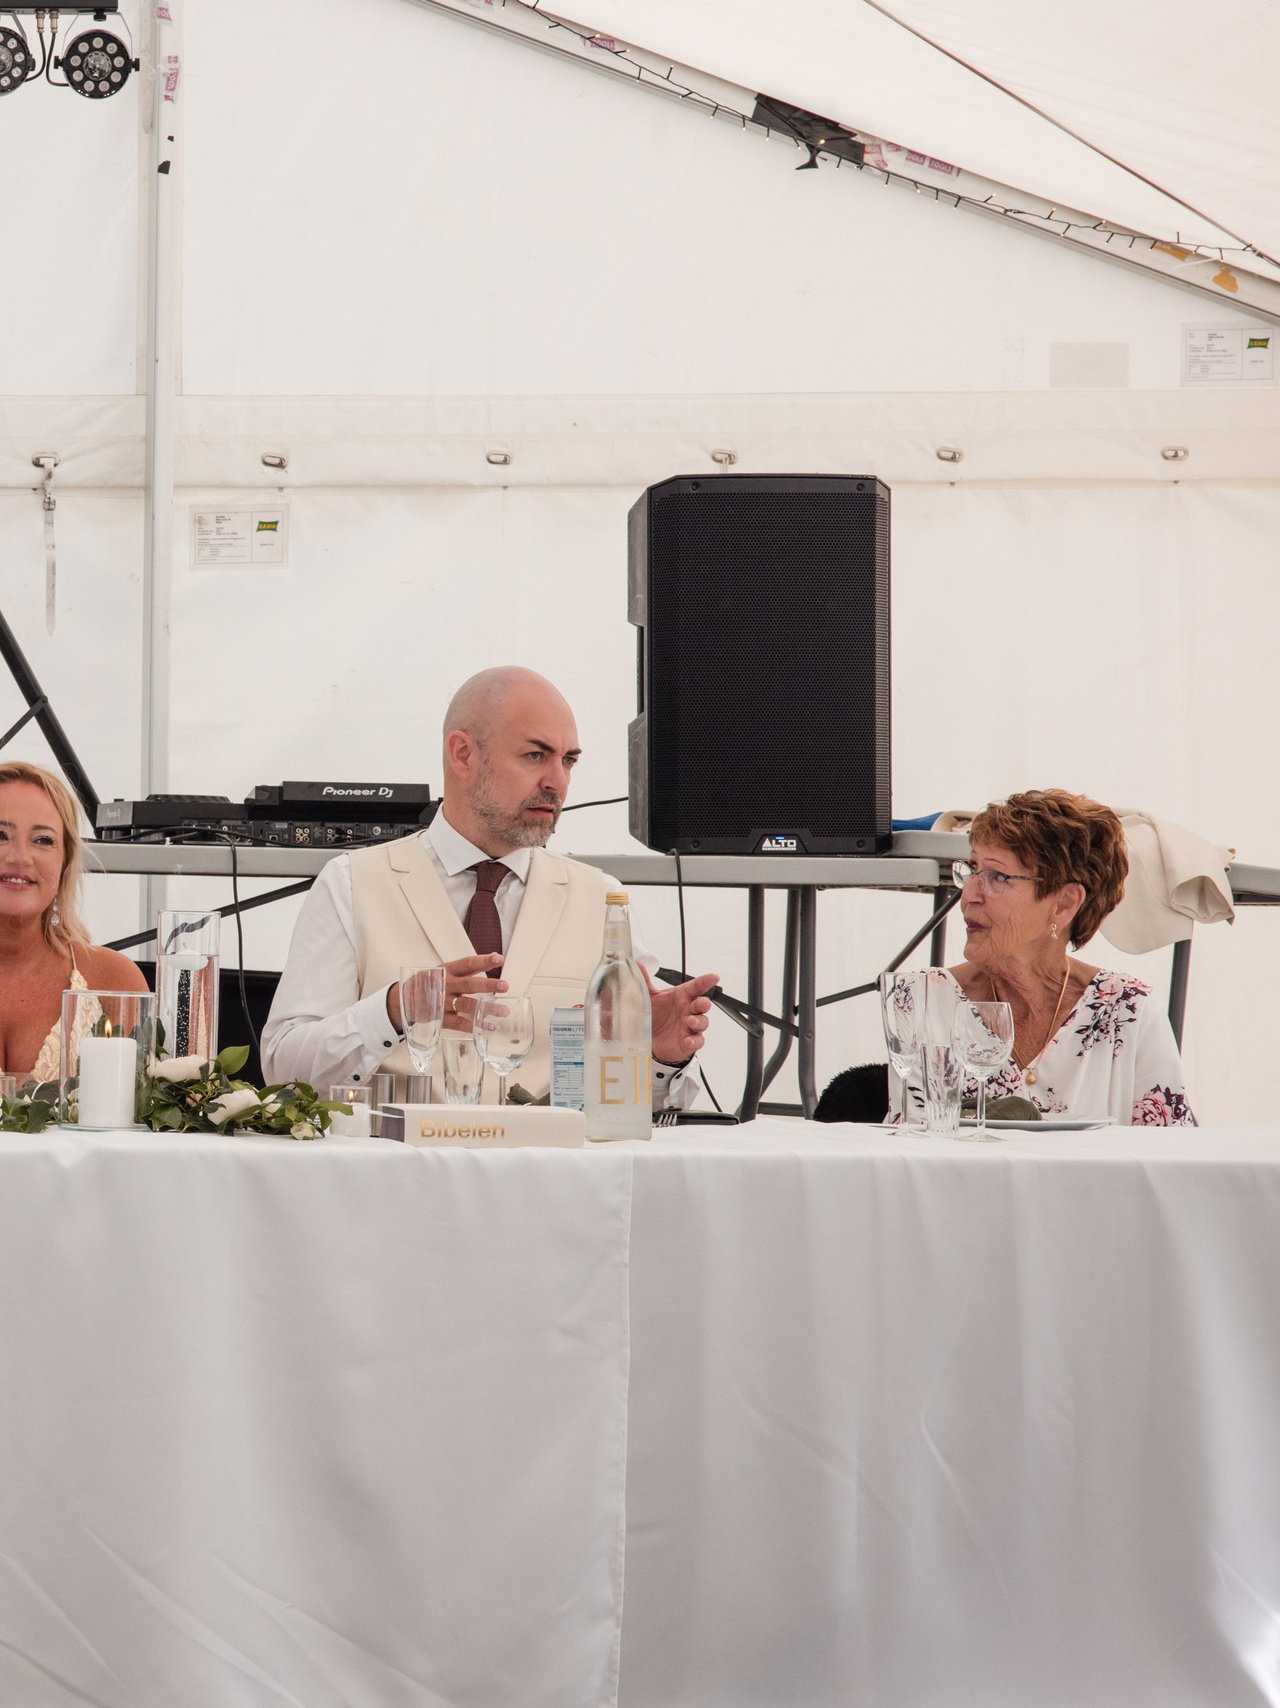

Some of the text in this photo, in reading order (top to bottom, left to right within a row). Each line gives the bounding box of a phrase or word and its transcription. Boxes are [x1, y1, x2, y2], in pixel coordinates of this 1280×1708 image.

[931, 160, 952, 172] TOOLS
[322, 786, 376, 796] Pioneer
[762, 838, 796, 847] ALTO
[599, 1056, 652, 1105] EI
[420, 1118, 506, 1139] Bibelen
